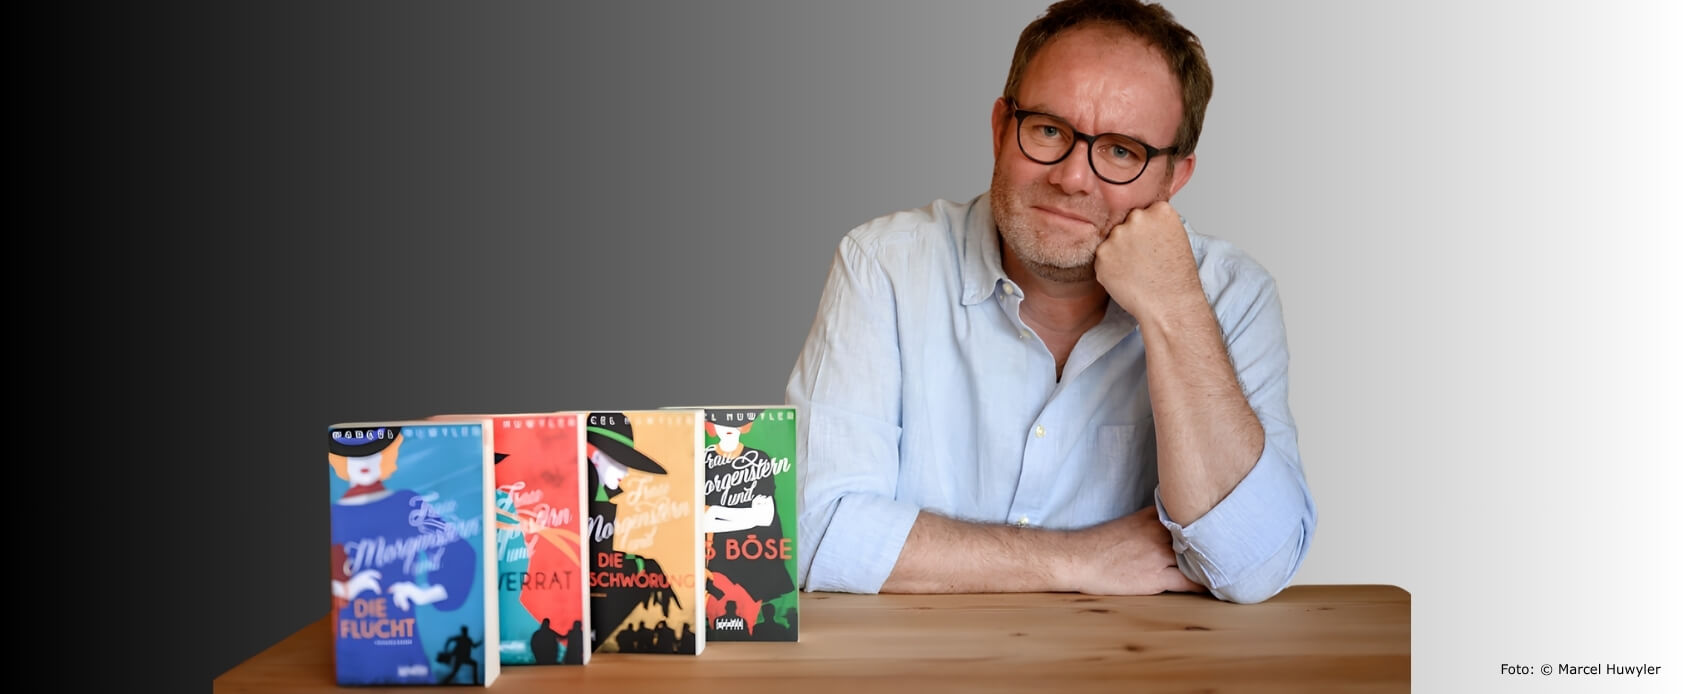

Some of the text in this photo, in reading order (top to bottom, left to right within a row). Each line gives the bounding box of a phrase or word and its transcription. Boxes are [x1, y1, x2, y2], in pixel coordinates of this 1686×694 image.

[726, 412, 795, 422] HUWYLER
[704, 450, 791, 506] orgenstern
[727, 480, 756, 507] und
[597, 552, 624, 569] DIE
[589, 569, 695, 589] SCHWÖRUNG
[353, 597, 387, 619] DIE
[340, 618, 415, 640] FLUCHT
